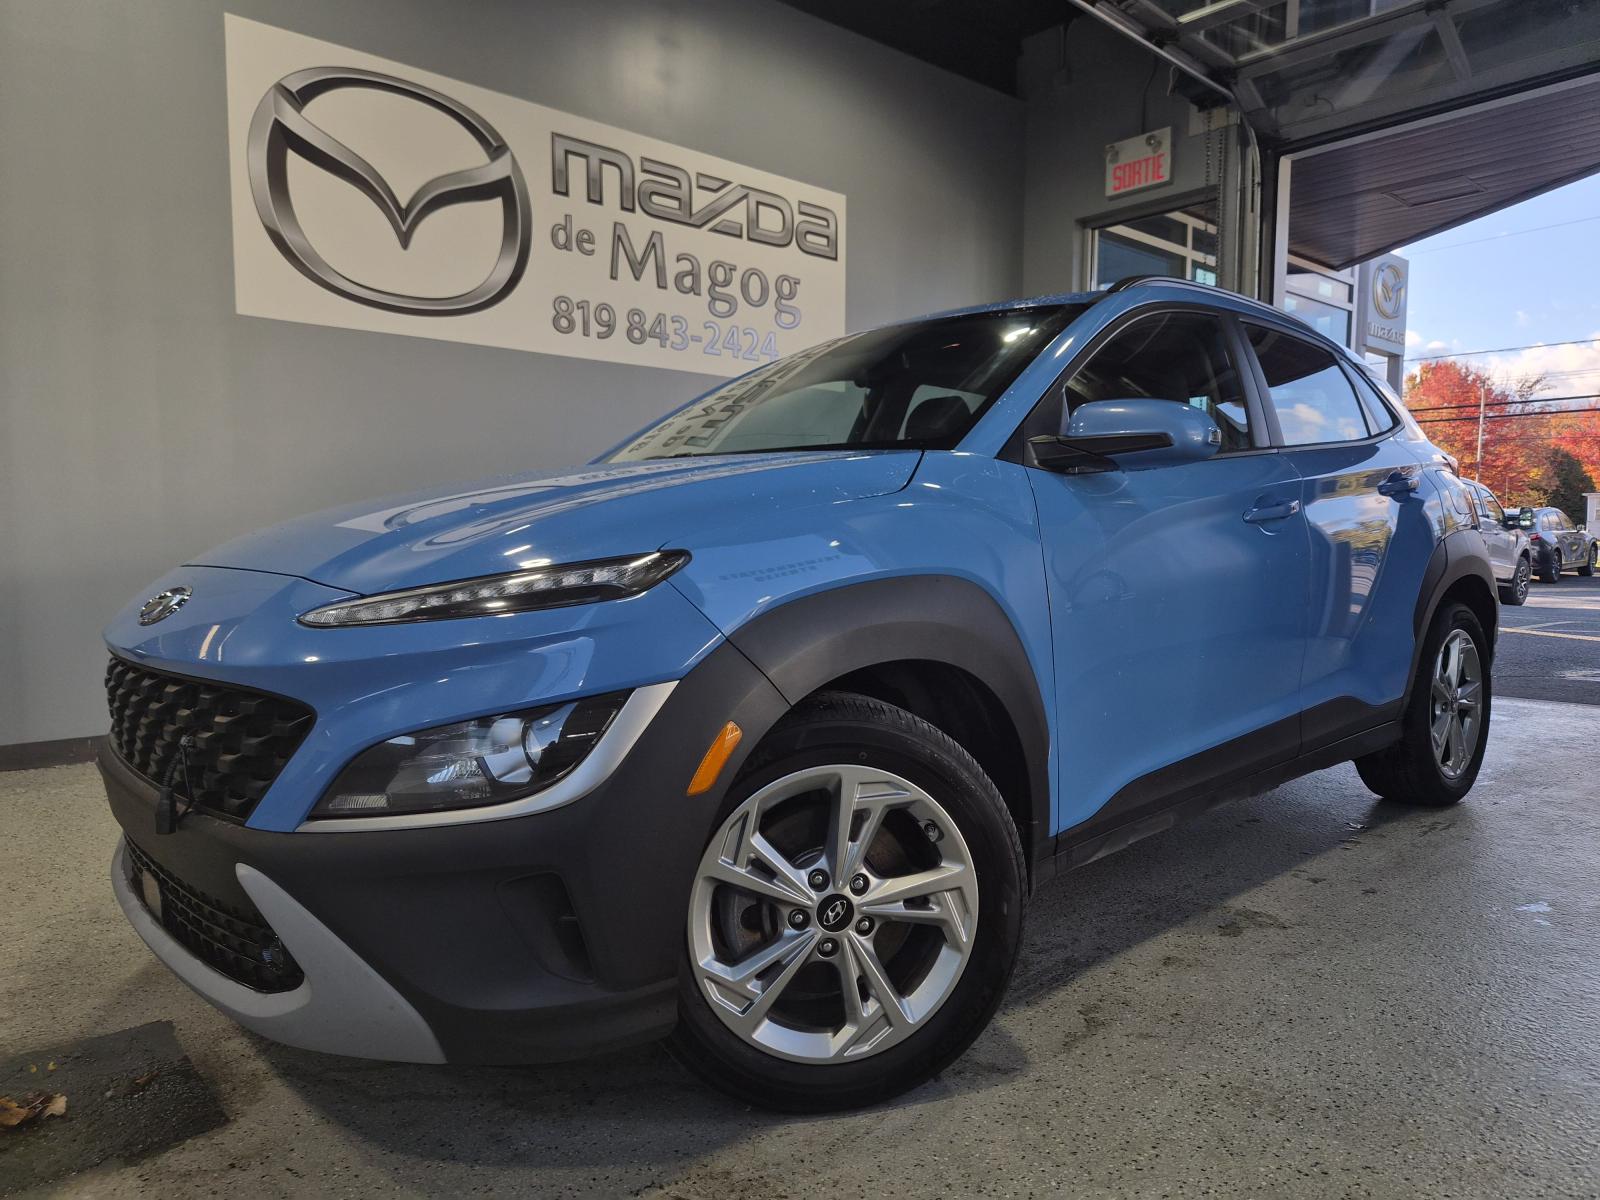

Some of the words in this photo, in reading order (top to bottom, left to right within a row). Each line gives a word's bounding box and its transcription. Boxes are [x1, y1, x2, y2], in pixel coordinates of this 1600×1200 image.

[551, 131, 838, 262] mazda
[1112, 153, 1166, 192] SORTIE
[551, 214, 596, 256] de
[610, 221, 801, 330] Magog
[552, 295, 617, 340] 819
[626, 308, 780, 362] 843-2424
